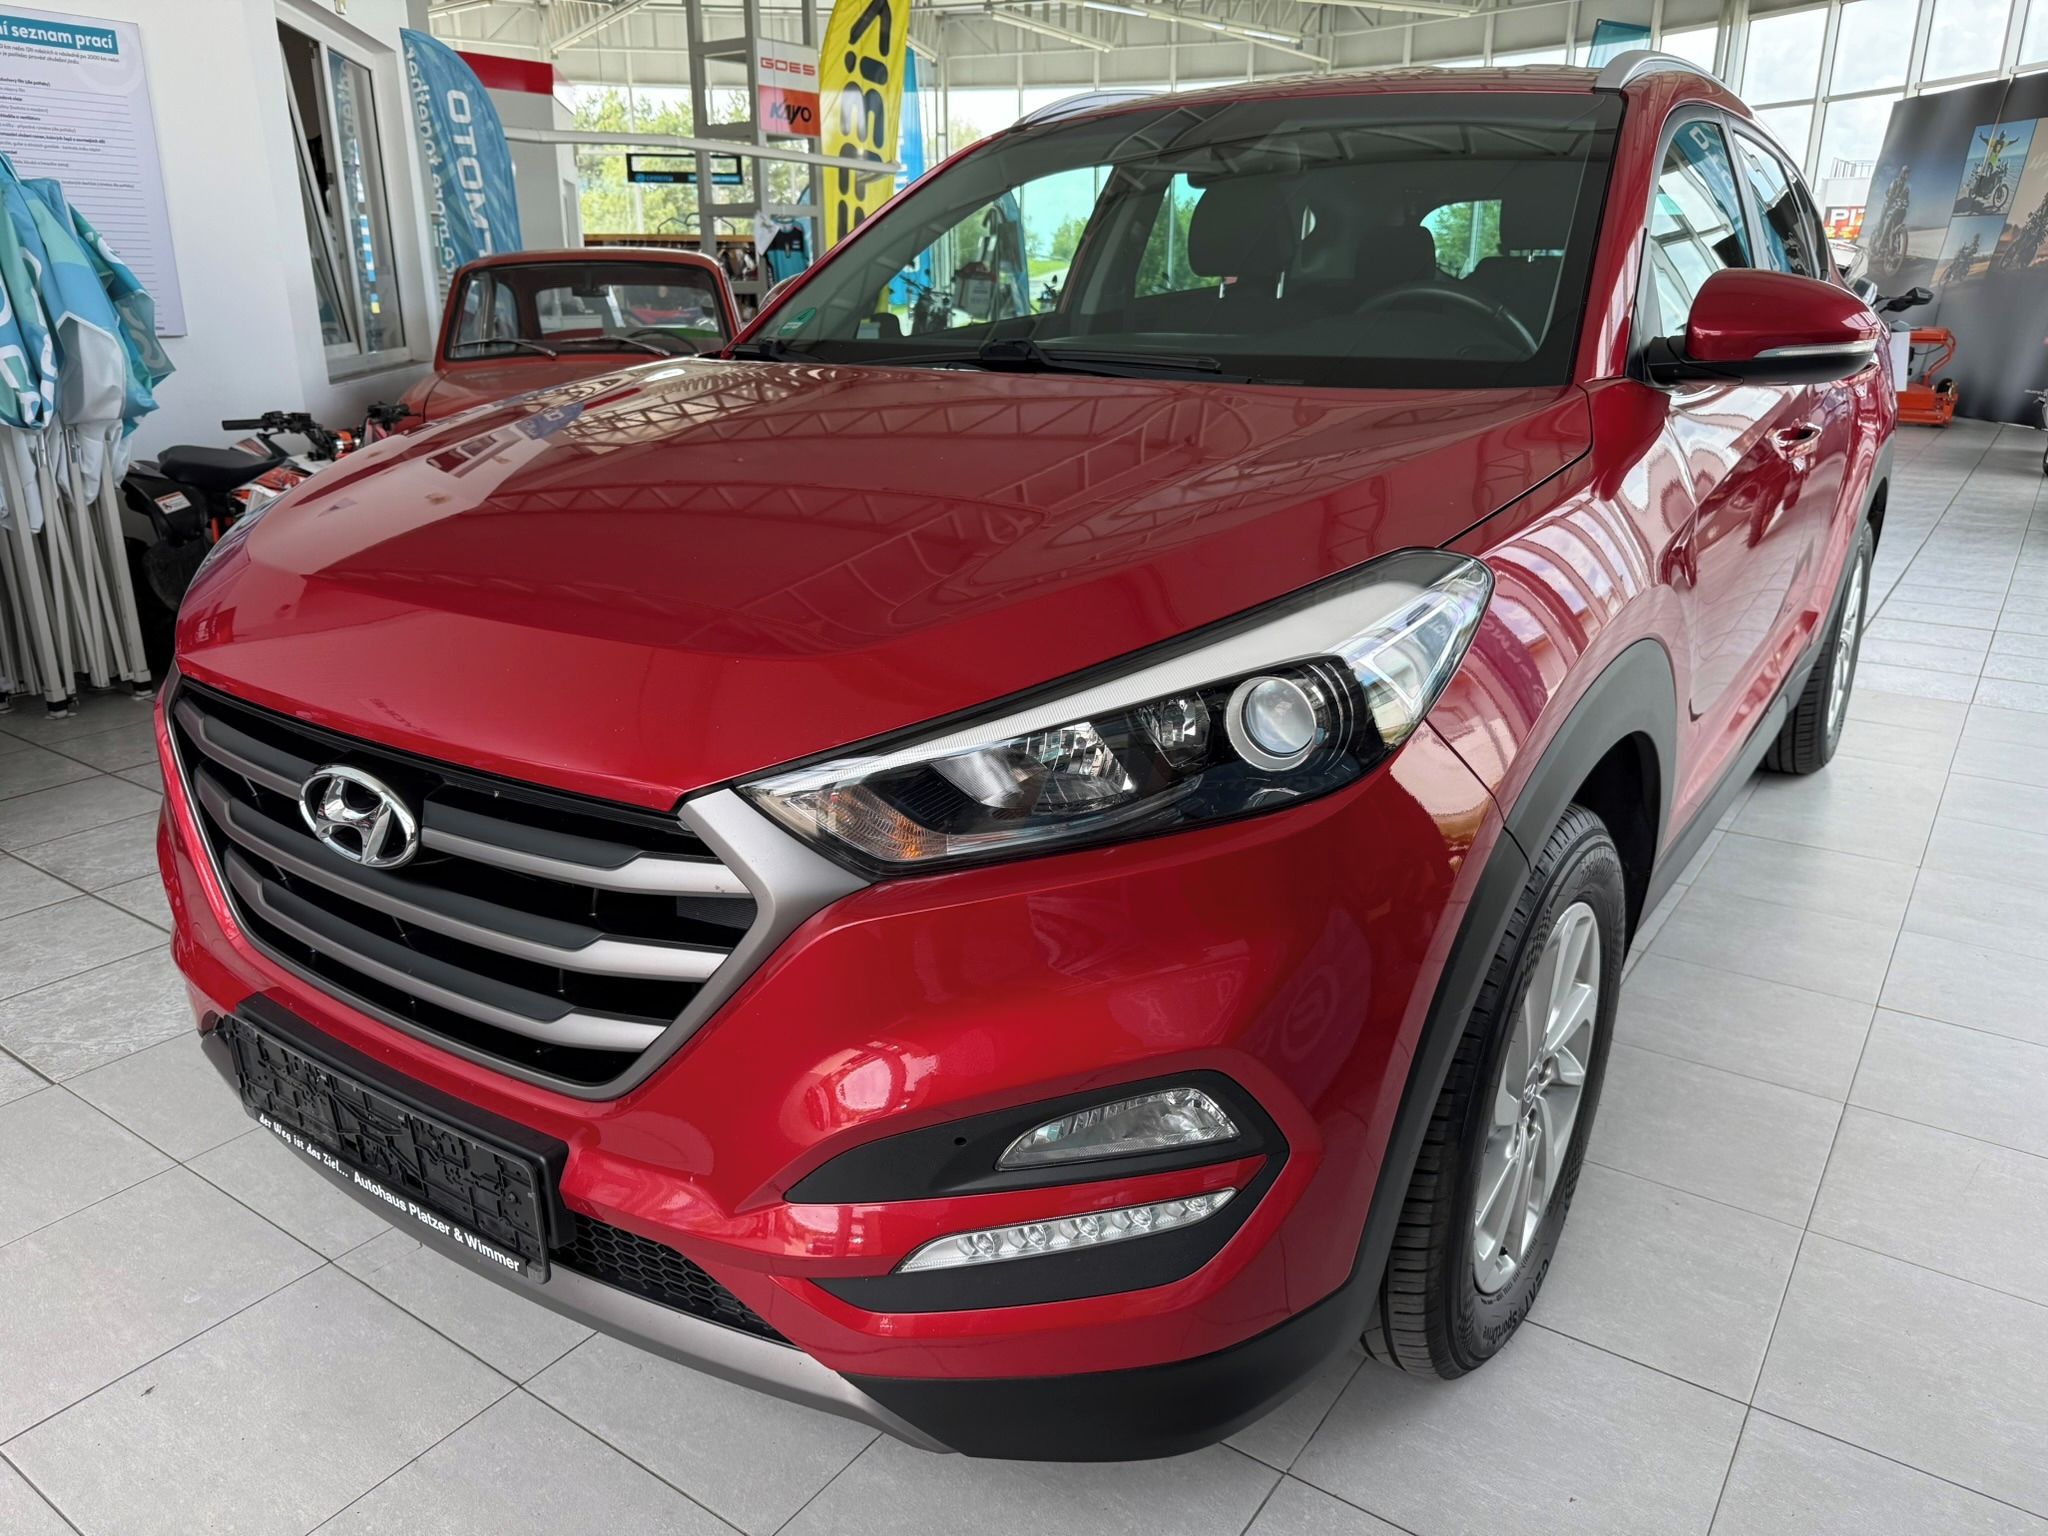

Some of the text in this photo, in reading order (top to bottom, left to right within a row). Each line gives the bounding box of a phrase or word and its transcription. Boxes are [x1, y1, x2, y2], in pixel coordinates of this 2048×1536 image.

[11, 25, 72, 44] seznam
[75, 34, 113, 50] prací
[760, 57, 816, 76] GOES
[770, 98, 812, 125] KAYO
[259, 1113, 272, 1128] der
[273, 1121, 291, 1143] Weg
[293, 1134, 304, 1150] ist
[306, 1143, 321, 1160] das
[354, 1171, 407, 1212] Autohaus
[408, 1202, 451, 1236] Platzer
[453, 1227, 465, 1244] &
[464, 1232, 520, 1272] Wimmer
